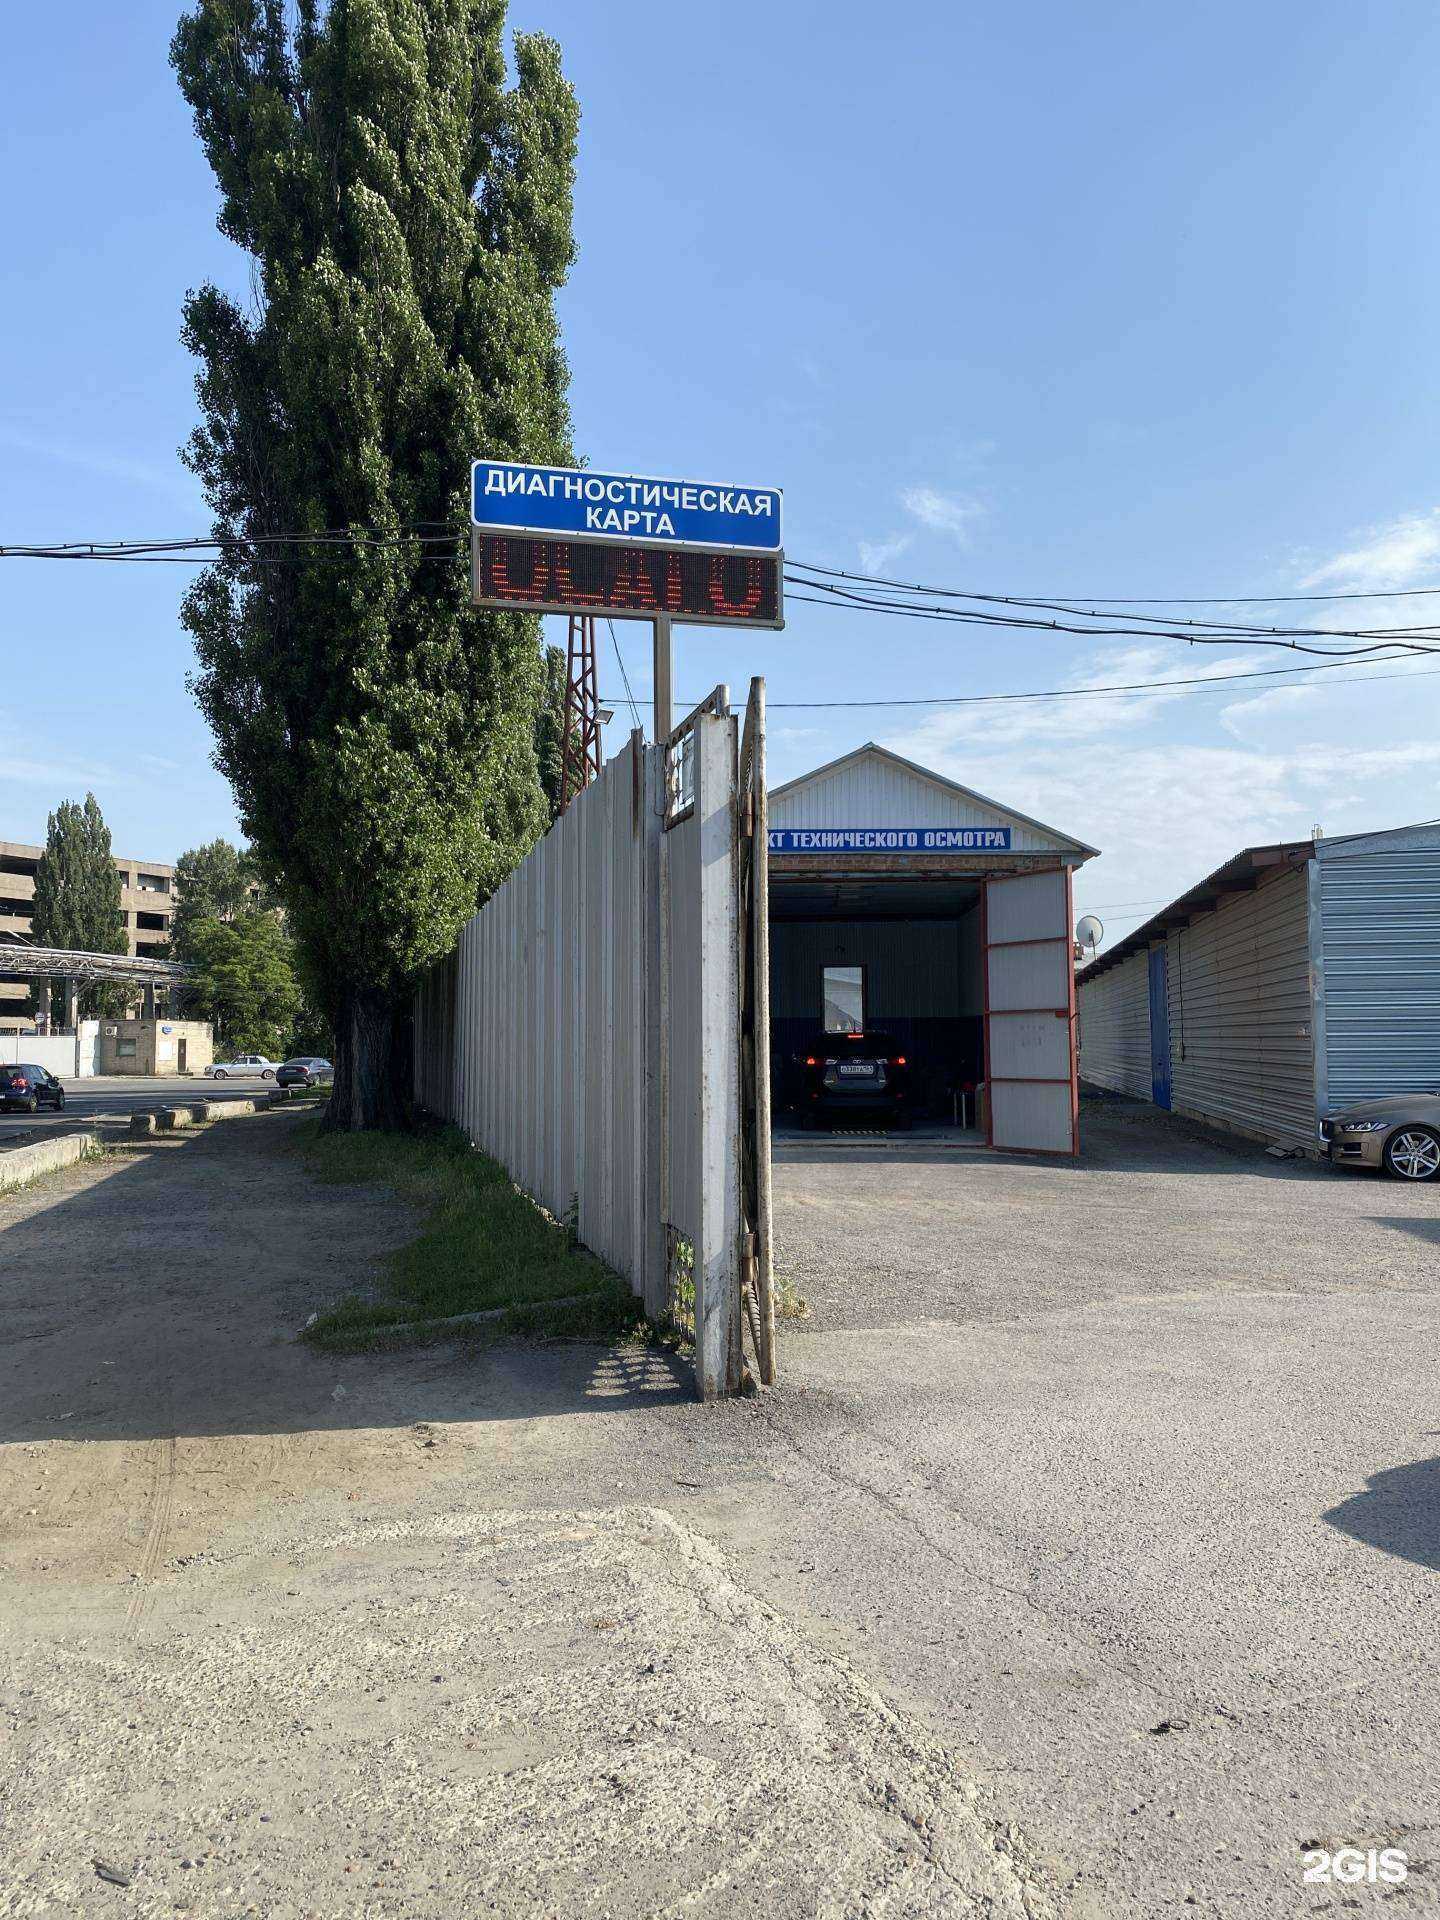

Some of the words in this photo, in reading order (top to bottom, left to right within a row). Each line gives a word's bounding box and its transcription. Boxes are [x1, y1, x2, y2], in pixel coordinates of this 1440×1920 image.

[485, 469, 772, 517] ДИАГНОСТИЧЕСКАЯ
[586, 506, 676, 536] КАРТА
[790, 831, 918, 848] ТЕХНИЧЕСКОГО
[924, 831, 1006, 847] ОСМОТРА
